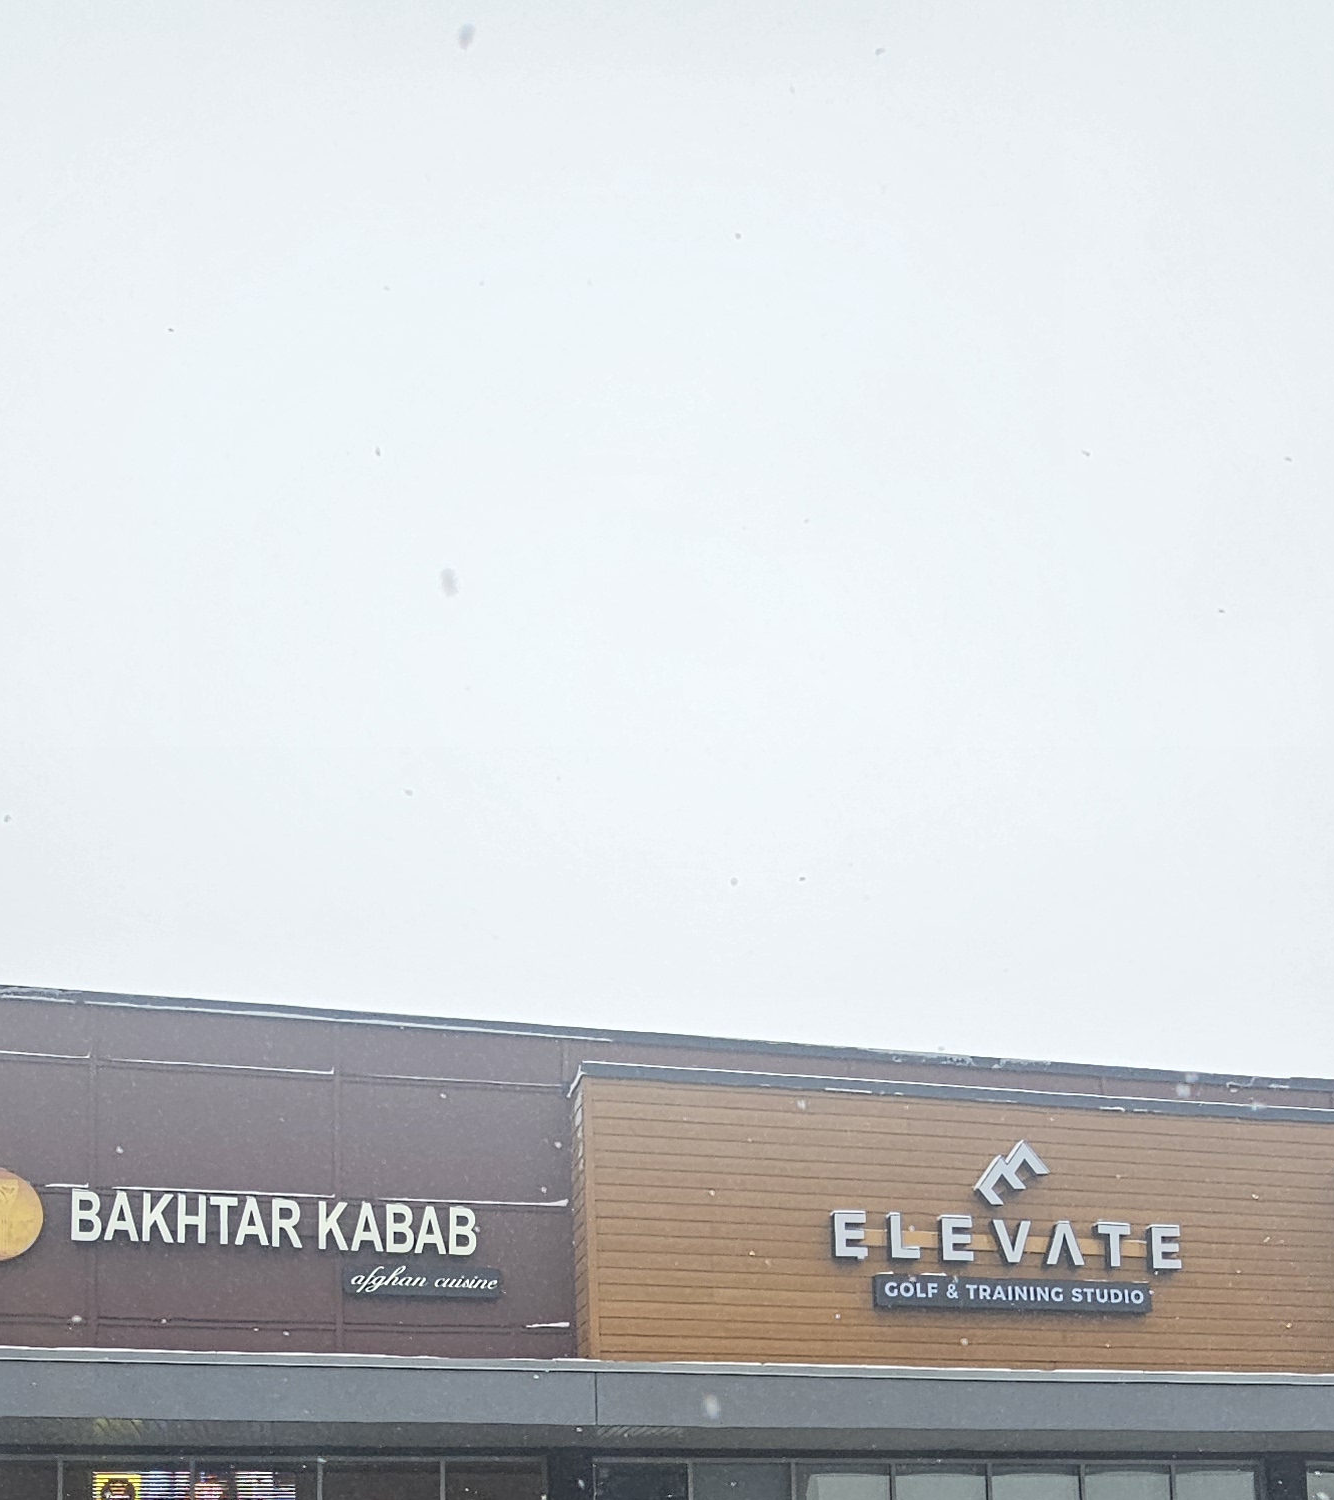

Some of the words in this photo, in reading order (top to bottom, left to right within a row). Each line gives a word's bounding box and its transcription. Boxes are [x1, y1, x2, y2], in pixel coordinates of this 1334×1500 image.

[71, 1189, 302, 1249] BAKHTAR
[318, 1201, 478, 1256] KABAB
[830, 1210, 1182, 1270] ELEVATE
[351, 1265, 428, 1293] afghan
[434, 1275, 498, 1290] cuisine
[884, 1281, 938, 1299] GOLF
[946, 1283, 959, 1299] &
[966, 1284, 1064, 1303] TRAINING
[1071, 1287, 1145, 1305] STUDIO
